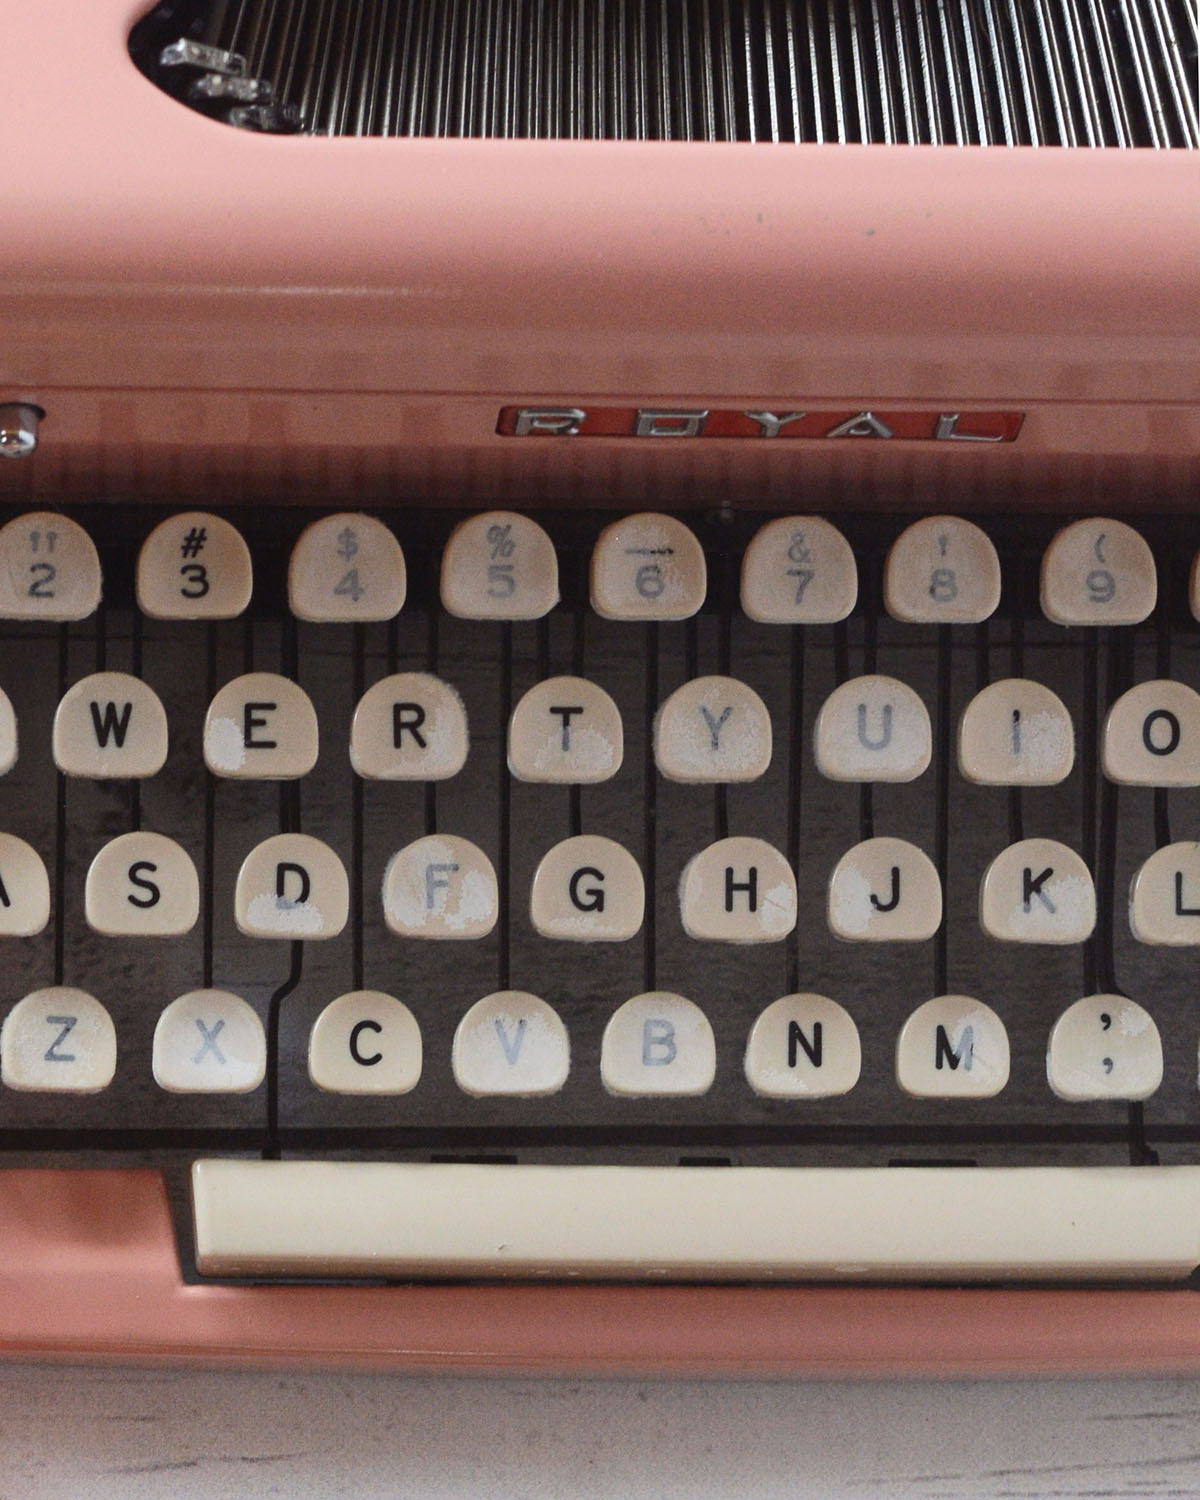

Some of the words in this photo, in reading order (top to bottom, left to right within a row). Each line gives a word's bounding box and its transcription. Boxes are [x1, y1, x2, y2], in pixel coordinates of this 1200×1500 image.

[514, 408, 1018, 442] ROYAL
[28, 563, 57, 599] 2
[181, 565, 210, 599] 3
[333, 570, 366, 603] 4
[486, 564, 517, 599] 5
[635, 565, 667, 599] 6
[786, 569, 815, 605] 7
[929, 569, 957, 604] 8
[1085, 569, 1116, 604] 9
[90, 701, 133, 748] W
[244, 701, 279, 749] E
[392, 702, 427, 749] R
[549, 705, 585, 752] T
[700, 705, 732, 751] Y
[858, 703, 893, 750] U
[1141, 709, 1182, 757] O
[126, 861, 162, 909] S
[276, 862, 311, 911] D
[425, 863, 461, 910] F
[569, 866, 606, 913] G
[725, 866, 758, 912] H
[870, 867, 902, 912] J
[1022, 867, 1057, 914] K
[1175, 871, 1200, 917] L
[44, 1016, 77, 1063] Z
[193, 1018, 226, 1065] X
[348, 1020, 384, 1068] C
[493, 1018, 526, 1066] V
[641, 1018, 678, 1066] B
[787, 1021, 823, 1068] N
[935, 1024, 974, 1070] M
